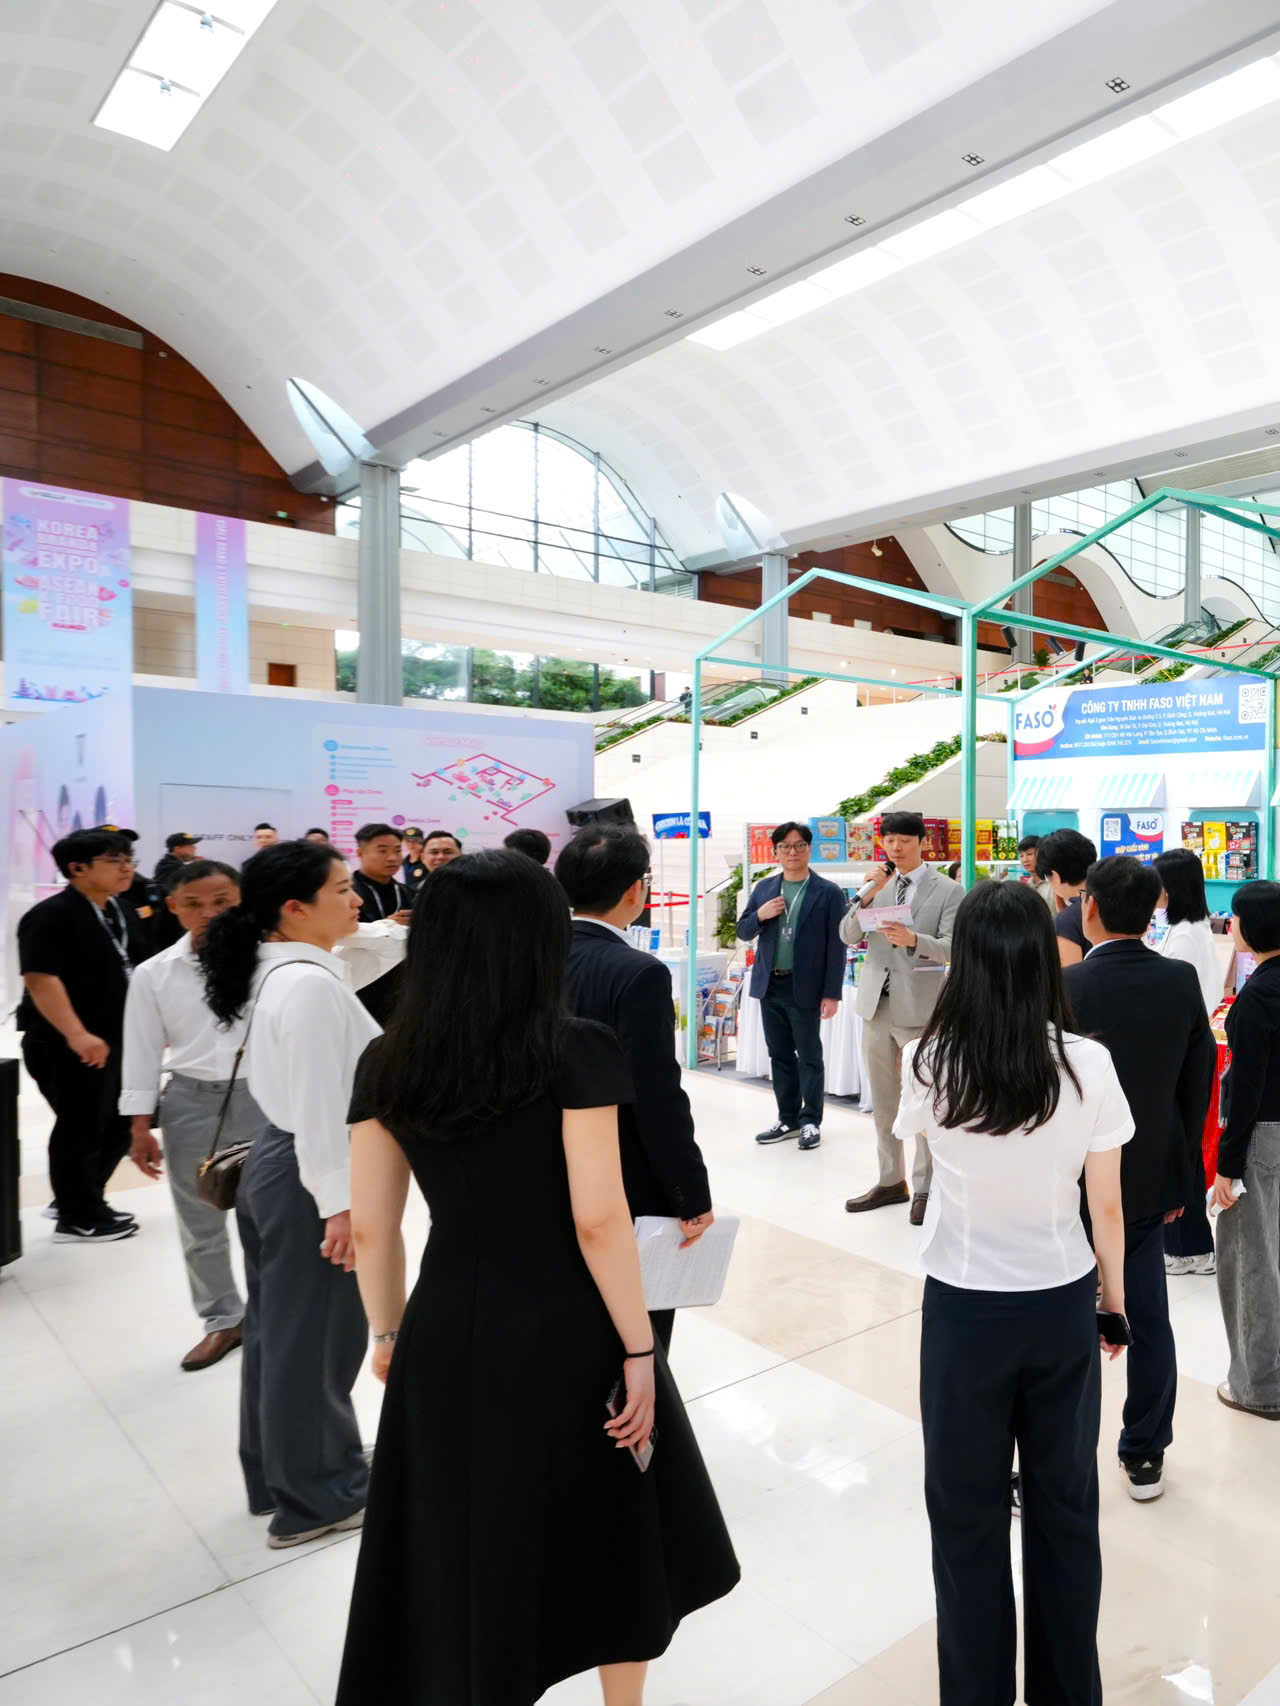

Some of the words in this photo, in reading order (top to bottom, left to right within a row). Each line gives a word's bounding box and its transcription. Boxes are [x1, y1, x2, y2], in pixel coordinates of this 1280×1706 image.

[1081, 699, 1106, 715] CÔNG
[1107, 700, 1119, 713] TY
[1121, 698, 1147, 712] TNHH
[1149, 696, 1173, 710] FASO
[1175, 692, 1197, 710] VIỆT
[1199, 692, 1223, 707] NAM
[1015, 708, 1054, 730] FASO
[1136, 820, 1157, 830] FASO
